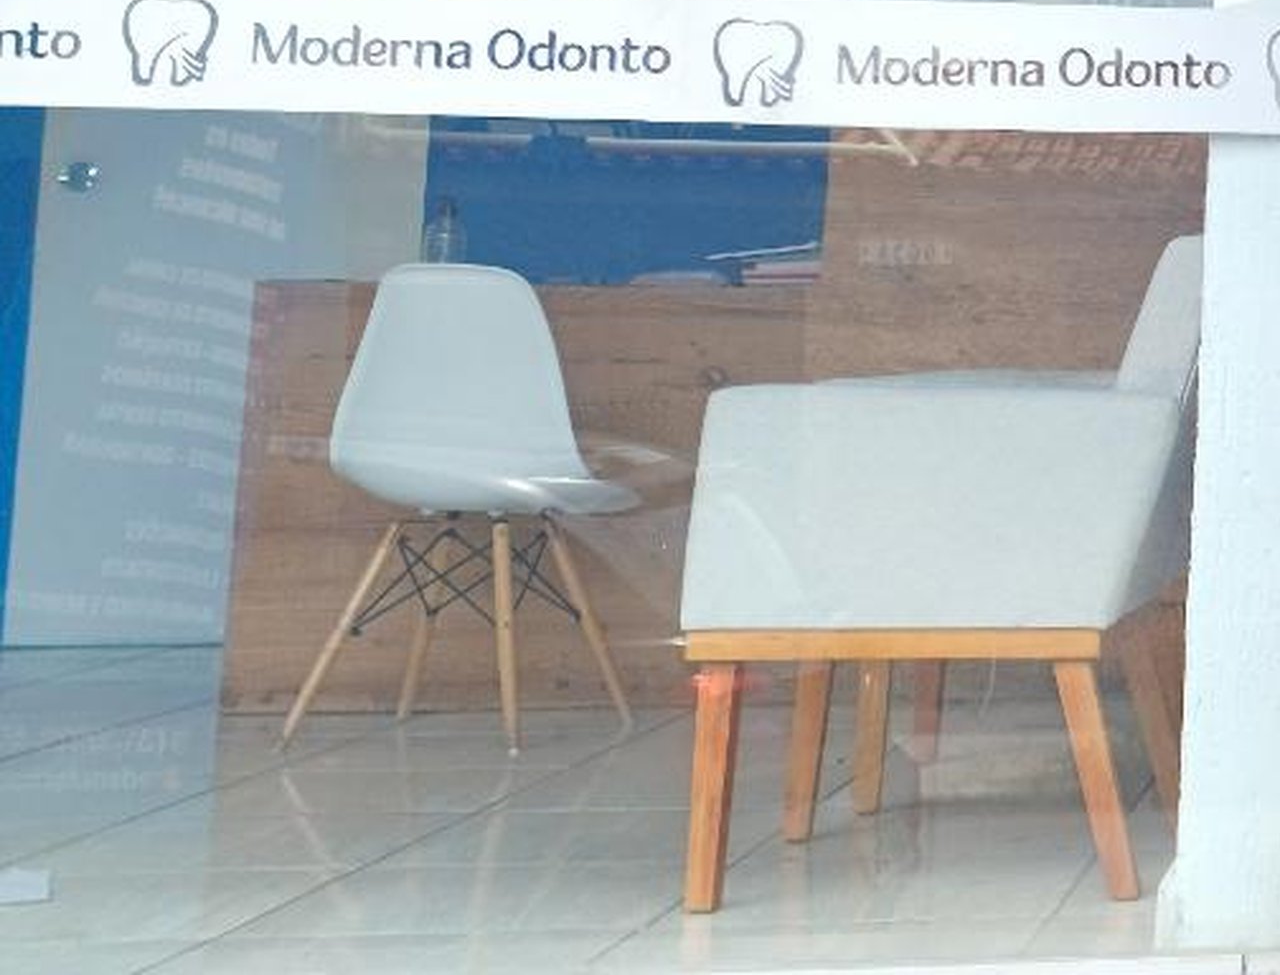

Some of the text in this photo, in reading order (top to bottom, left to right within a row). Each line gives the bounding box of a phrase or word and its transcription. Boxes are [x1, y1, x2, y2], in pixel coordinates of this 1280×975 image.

[250, 23, 671, 74] Moderna Odonto
[836, 43, 1231, 90] Moderna Odonto
